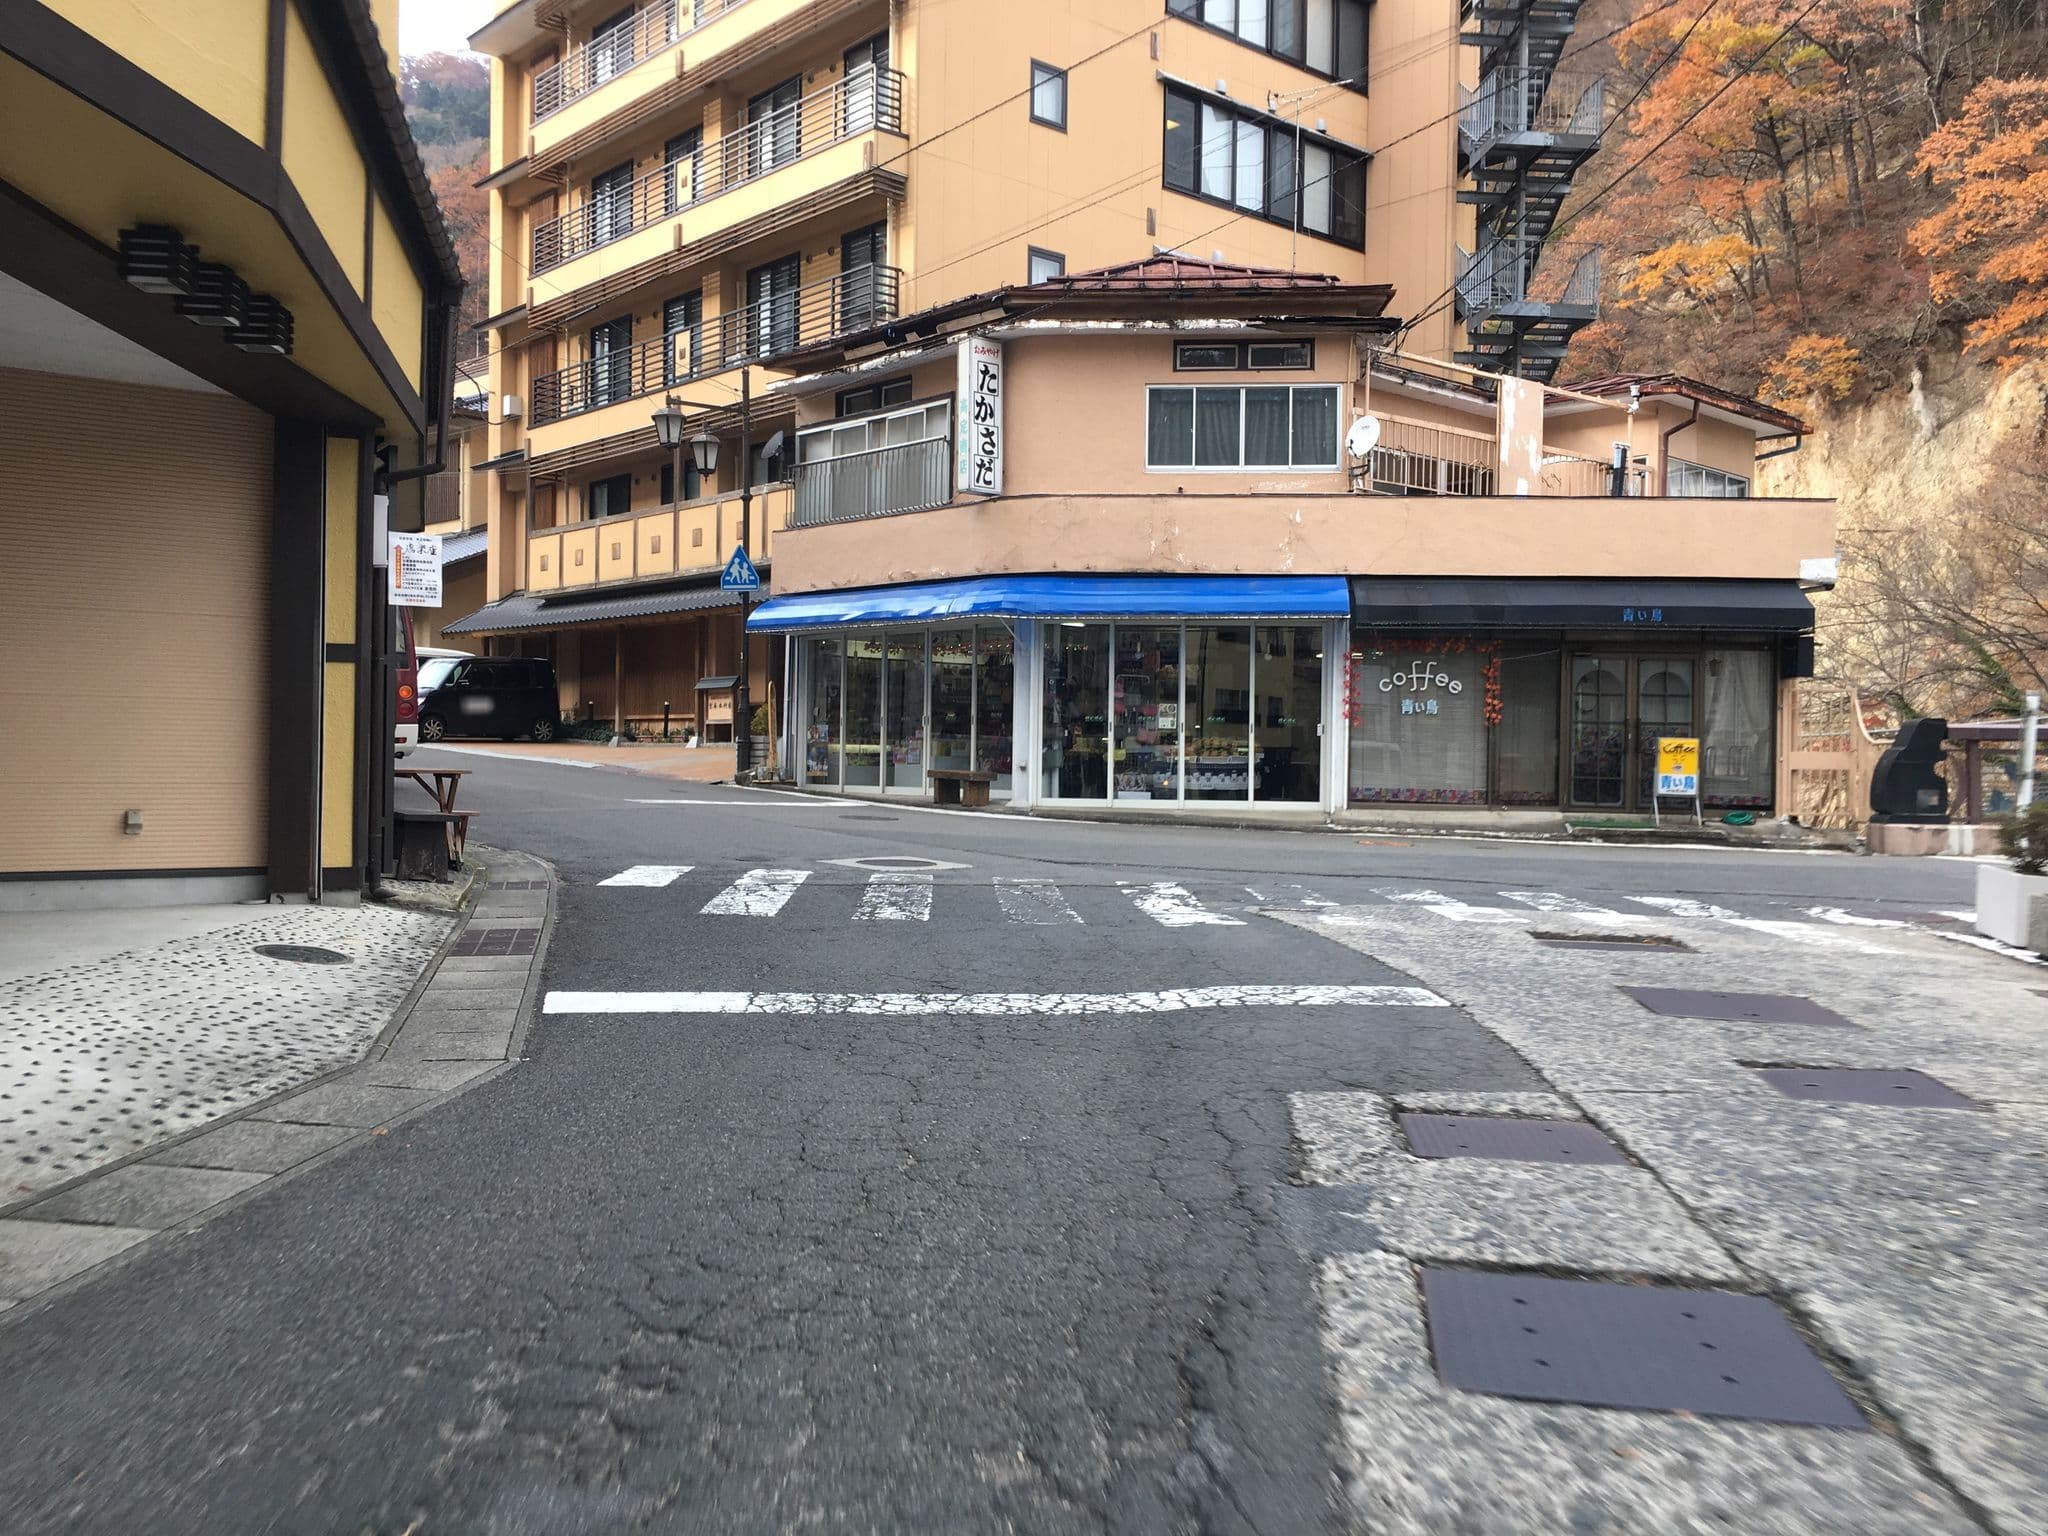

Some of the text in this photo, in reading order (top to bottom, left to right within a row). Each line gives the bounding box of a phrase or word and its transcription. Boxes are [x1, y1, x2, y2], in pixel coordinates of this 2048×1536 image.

[974, 364, 998, 486] たかさだ
[1623, 608, 1663, 623] 青い鳥
[1379, 660, 1462, 694] coffee
[1401, 698, 1439, 715] 青い鳥
[1661, 775, 1695, 790] 青い鳥
